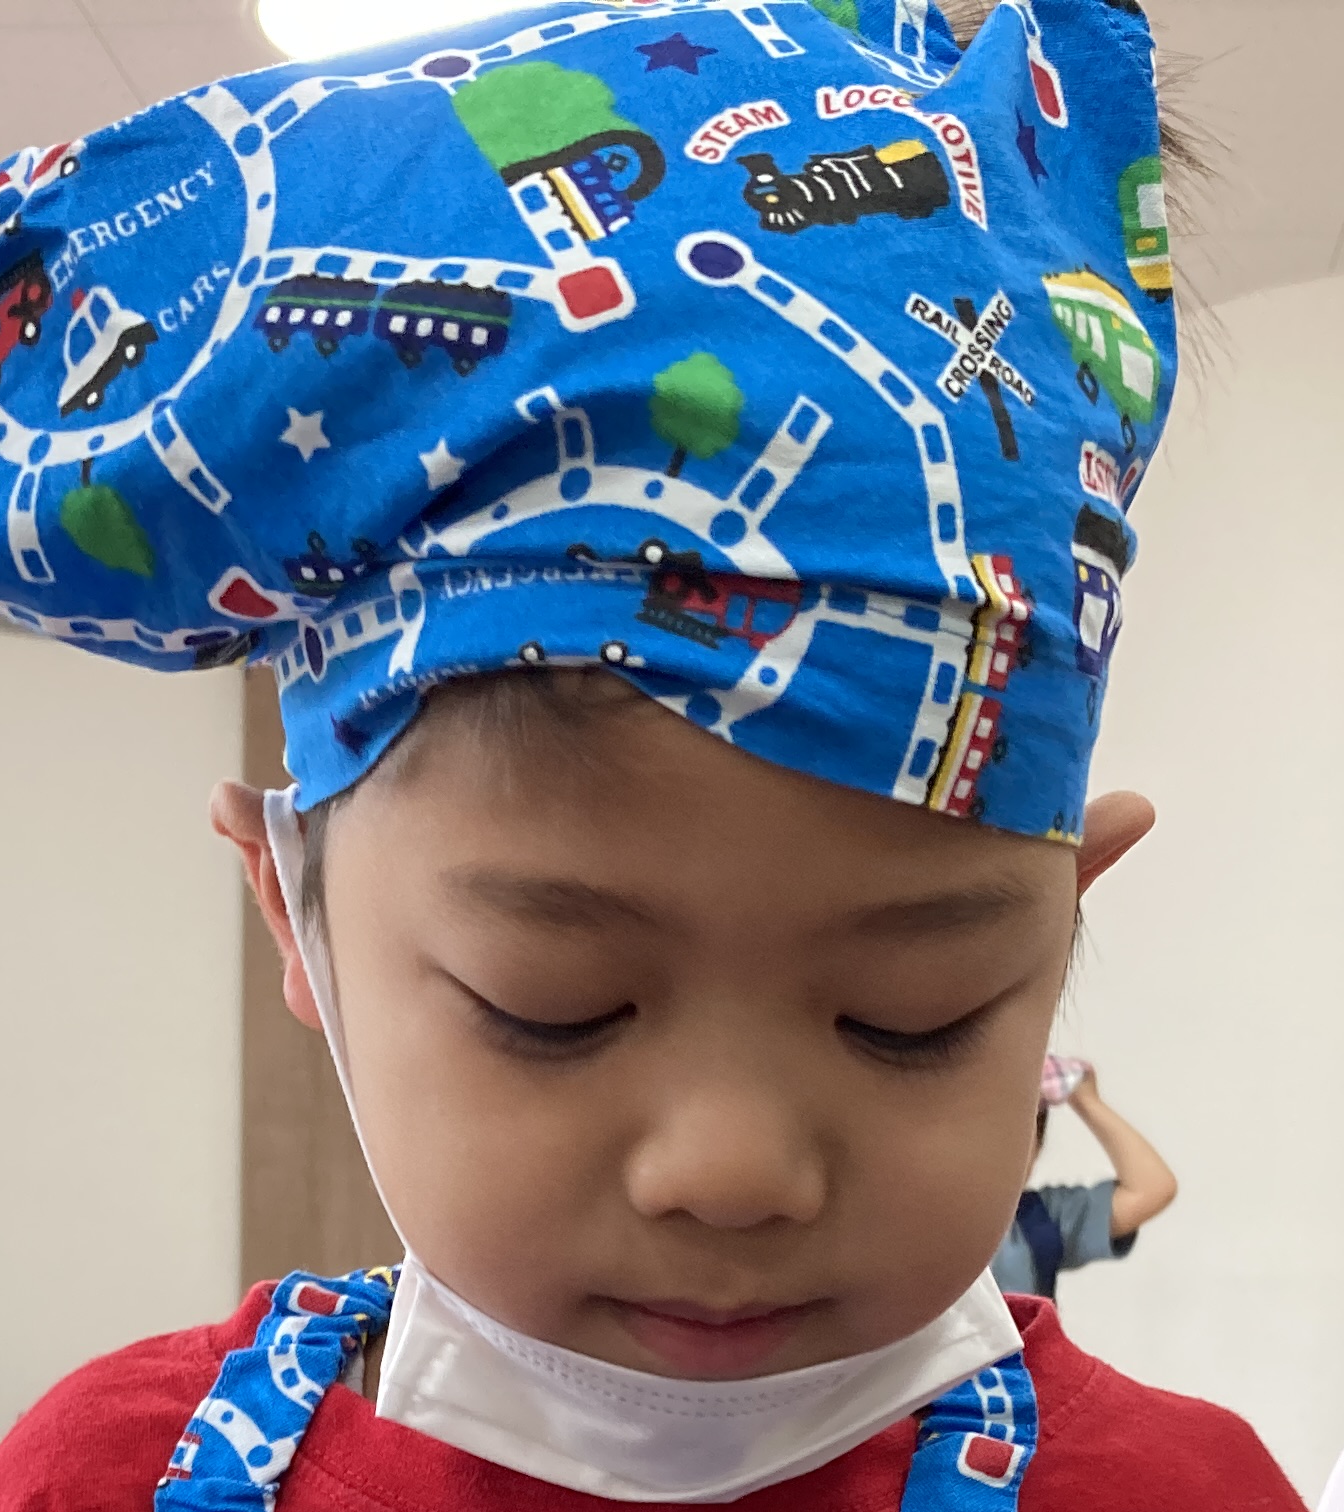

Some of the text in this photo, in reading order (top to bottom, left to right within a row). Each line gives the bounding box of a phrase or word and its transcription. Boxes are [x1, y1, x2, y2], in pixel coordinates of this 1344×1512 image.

[693, 105, 783, 161] STEAM
[49, 160, 216, 292] EMERGENCY
[910, 298, 1035, 405] RAIL ROAD
[944, 298, 1014, 399] CROSSING
